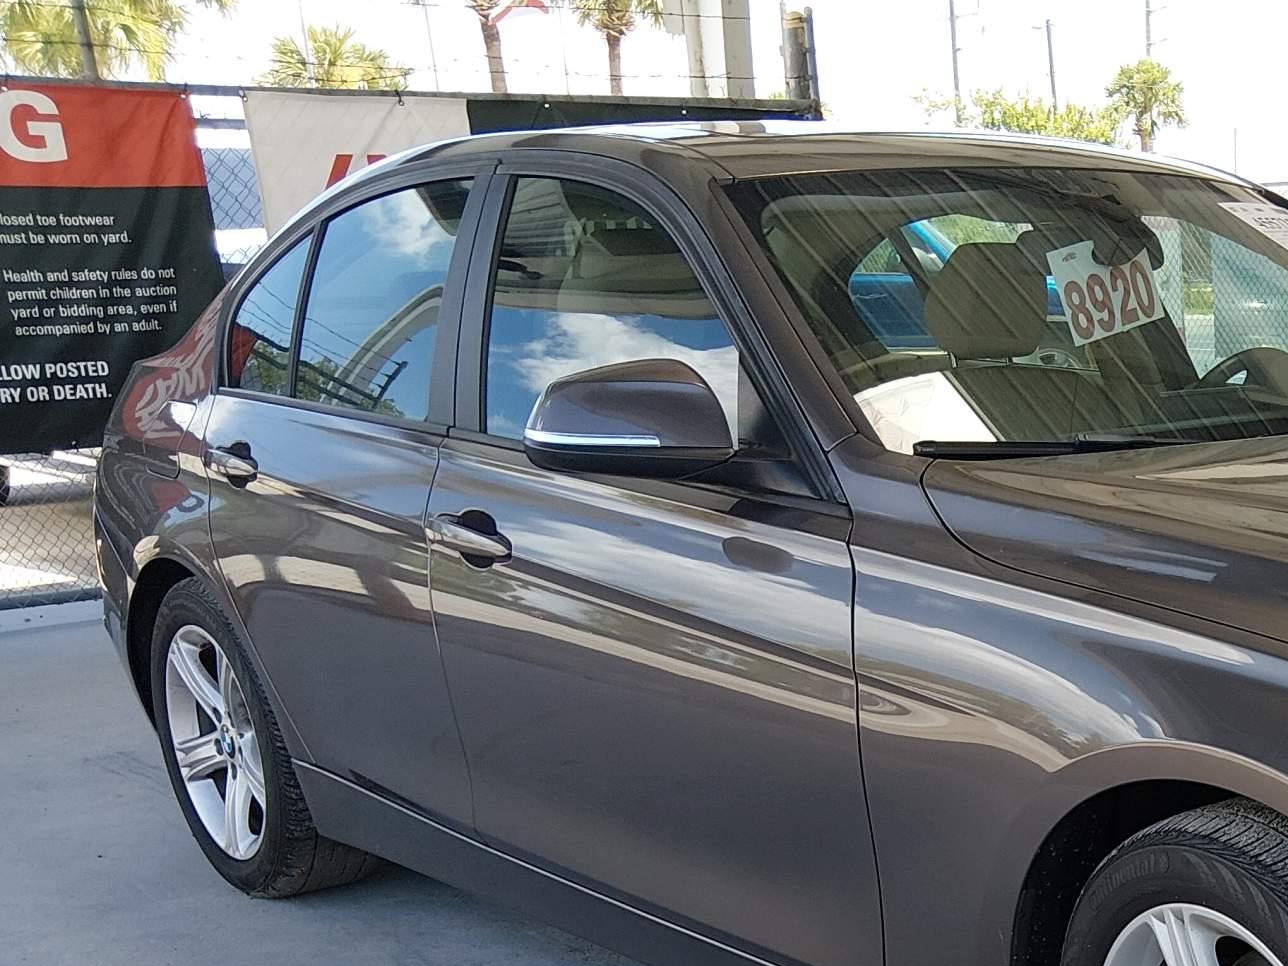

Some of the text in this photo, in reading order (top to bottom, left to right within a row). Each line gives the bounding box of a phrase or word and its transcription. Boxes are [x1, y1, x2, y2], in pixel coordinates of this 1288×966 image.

[36, 214, 56, 226] toe
[59, 213, 115, 226] footwear
[29, 231, 45, 244] be
[48, 234, 80, 244] worn
[83, 233, 98, 243] on
[101, 230, 132, 246] yard.
[2, 267, 176, 283] Health and safety rules do not
[7, 284, 177, 303] permit children in the auction
[1063, 260, 1156, 340] 8920
[11, 300, 178, 320] yard or bidding area, even if
[15, 319, 162, 337] accompanied by an adult.
[0, 361, 109, 380] LOW POSTED
[26, 386, 50, 402] OR
[52, 383, 112, 400] DEATH.
